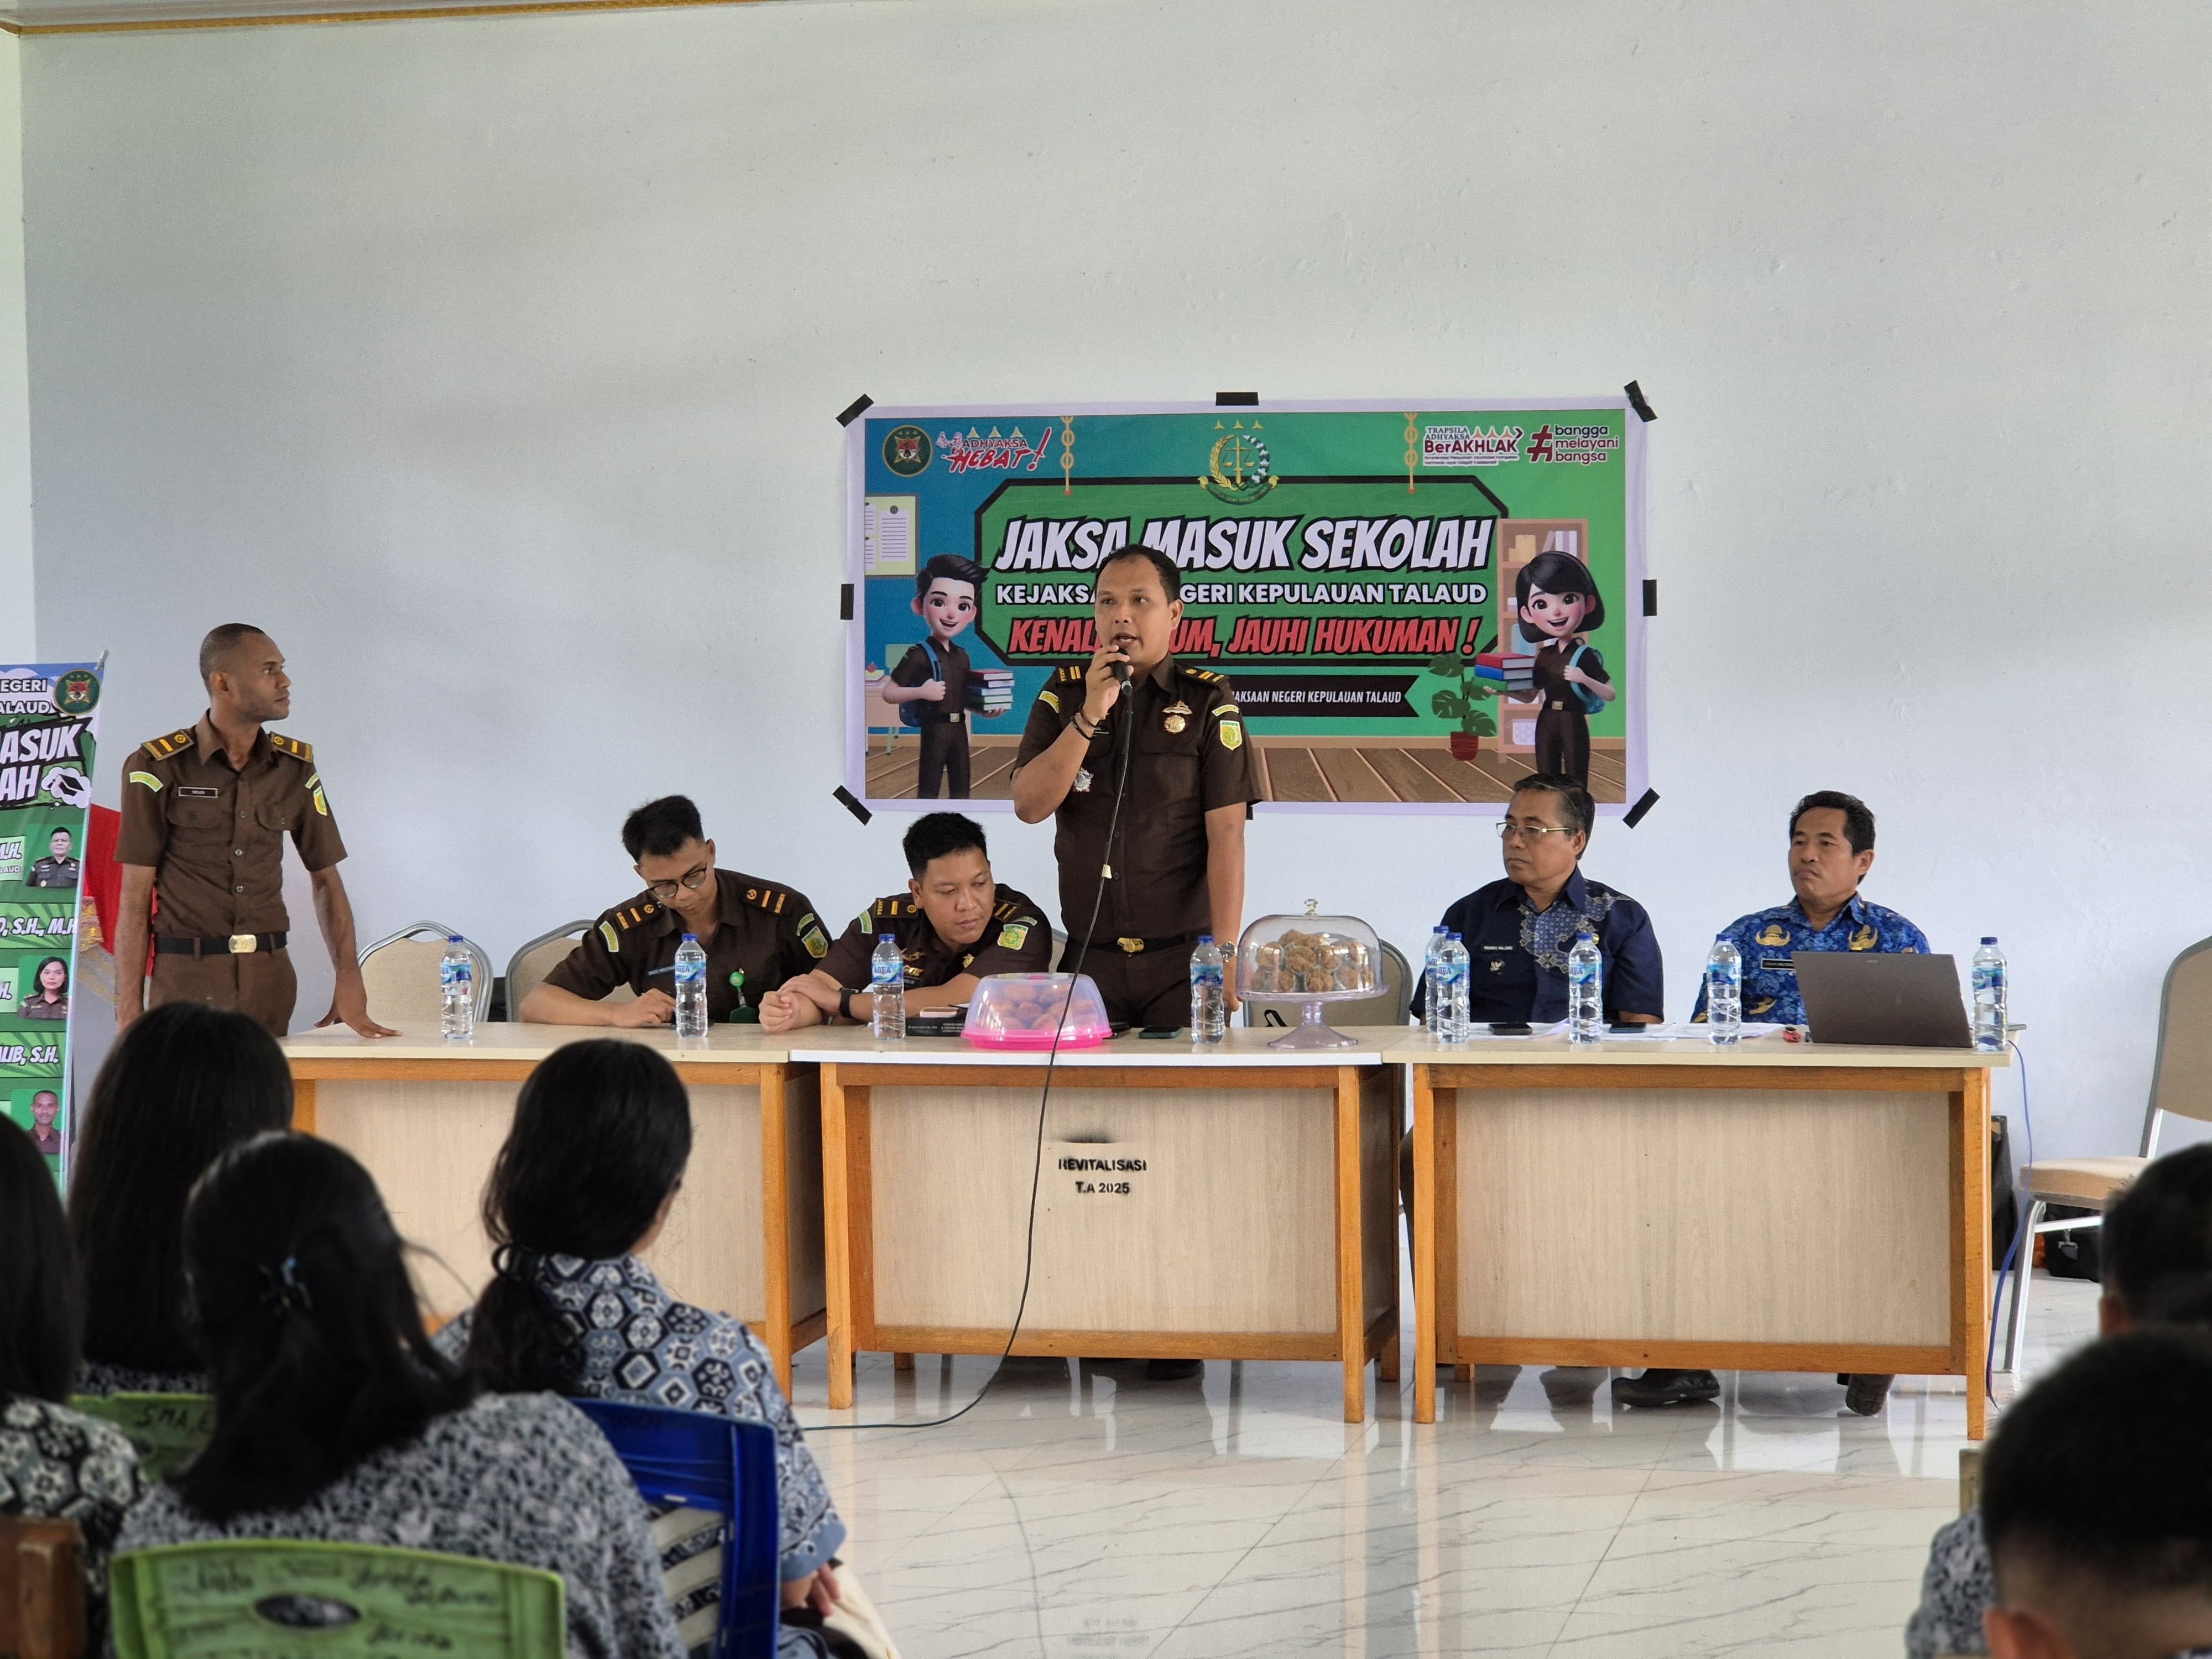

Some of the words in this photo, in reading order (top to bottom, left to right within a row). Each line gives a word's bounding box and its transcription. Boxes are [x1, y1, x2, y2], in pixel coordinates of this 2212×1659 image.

[1554, 425, 1608, 439] bangga
[962, 439, 1028, 448] ADHYAKSA
[1424, 440, 1518, 453] BerAKHLAK
[1554, 436, 1619, 452] melayani
[1554, 451, 1607, 465] bangsa
[994, 519, 1128, 570] JAKSA
[1141, 519, 1297, 570] MASUK
[1301, 518, 1494, 570] SEKOLAH
[997, 585, 1095, 604] KEJAKS
[1239, 583, 1384, 604] KEPULAUAN
[1389, 584, 1486, 603] TALAUD
[1227, 618, 1310, 654] JAUHI
[1313, 618, 1459, 654] HUKUMAN
[1232, 691, 1270, 703] AKSAAN
[1271, 691, 1306, 703] NEGERI
[1307, 691, 1364, 703] KEPULAUAN
[1365, 691, 1402, 703] TALAUD
[0, 723, 84, 765] ASUK
[29, 1046, 59, 1063] S.H.
[1058, 1158, 1147, 1172] REVITALISASI
[1074, 1181, 1096, 1193] T.A
[1098, 1182, 1130, 1193] 2025
